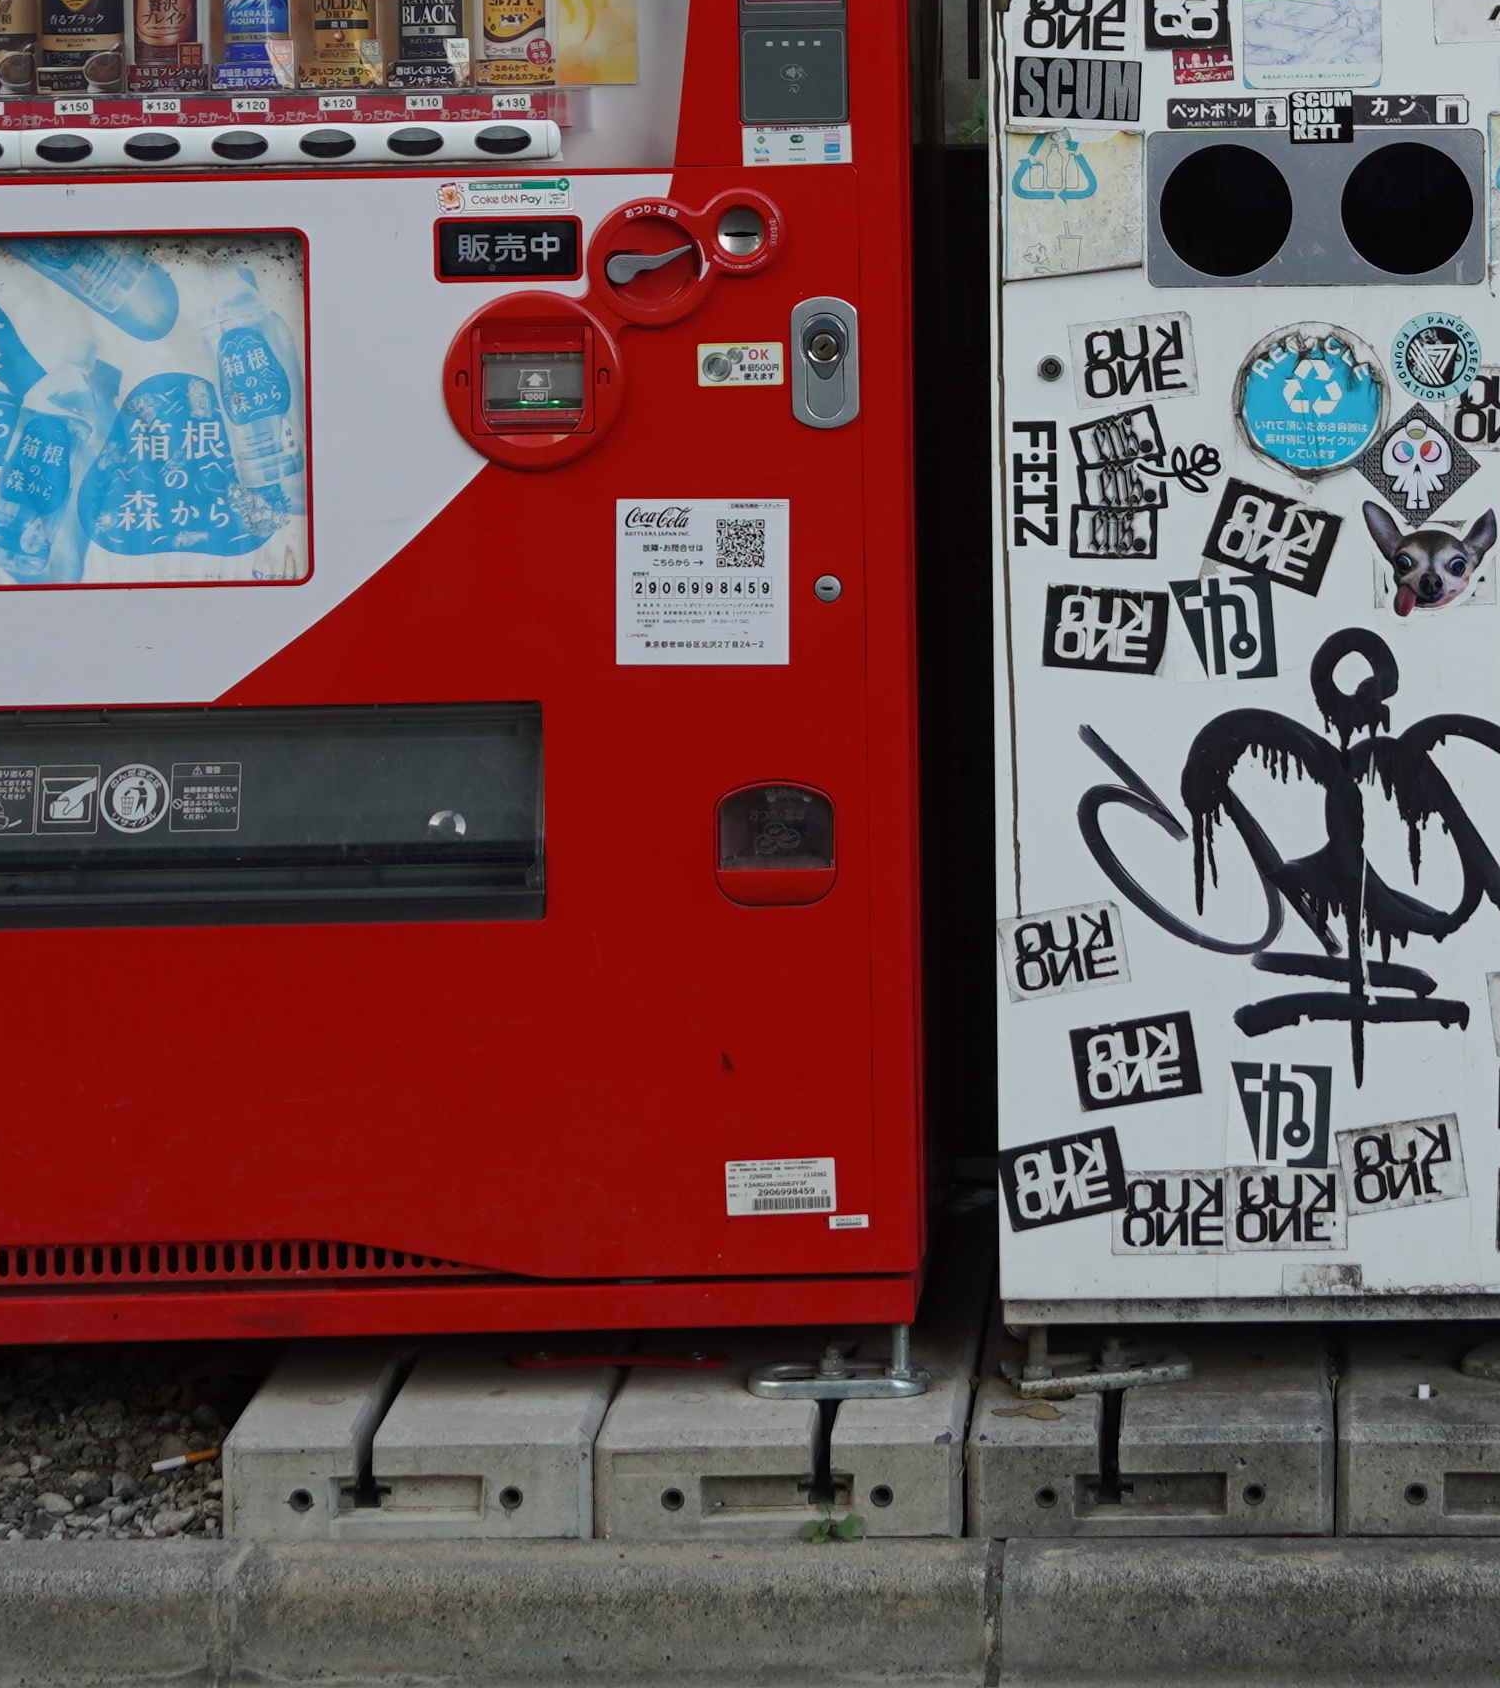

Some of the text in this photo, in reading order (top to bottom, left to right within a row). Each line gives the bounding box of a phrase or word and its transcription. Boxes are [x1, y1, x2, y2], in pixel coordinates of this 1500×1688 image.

[401, 6, 456, 25] BLACK
[1018, 59, 1139, 119] SCUM
[1292, 92, 1352, 108] SCUM
[1171, 103, 1252, 118] ペットボトル
[1370, 97, 1417, 116] カン
[1293, 124, 1342, 141] KETT
[457, 233, 561, 263] 販売中
[748, 349, 770, 360] OK
[1427, 315, 1478, 383] PANGEASEED
[1395, 332, 1446, 400] FOUNDATION
[19, 433, 65, 467] 箱根
[129, 419, 227, 462] 箱根
[1286, 448, 1338, 460] しています
[5, 469, 52, 502] 森から
[164, 467, 190, 489] の
[117, 489, 230, 533] 森から
[625, 506, 693, 529] Coca-Cola
[633, 581, 771, 595] 2906998459
